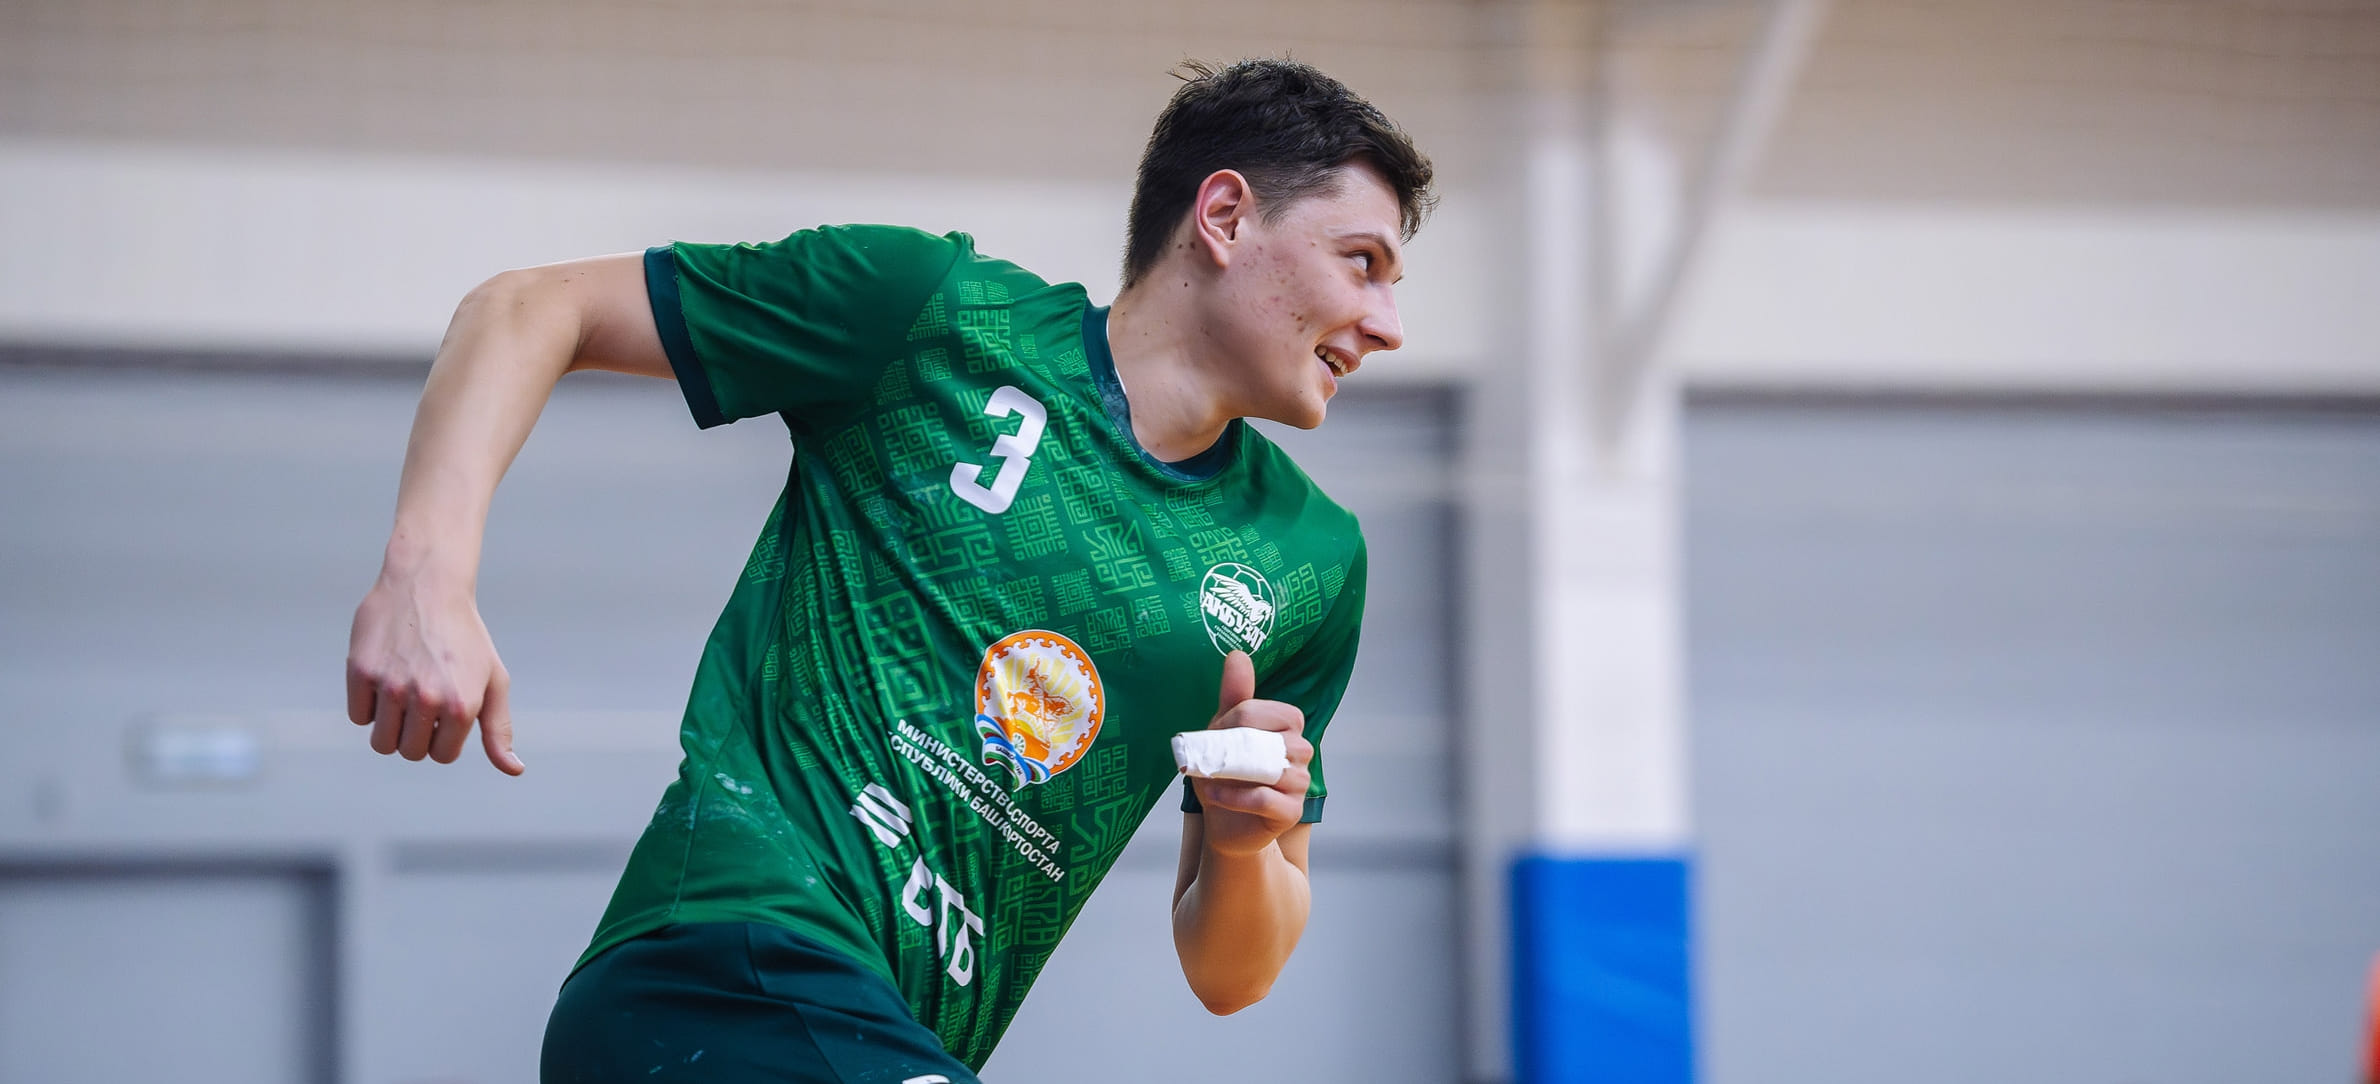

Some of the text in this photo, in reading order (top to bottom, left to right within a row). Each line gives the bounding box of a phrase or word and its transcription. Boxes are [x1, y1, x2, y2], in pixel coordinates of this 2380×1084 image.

[950, 385, 1047, 514] 3
[1200, 591, 1267, 651] АКБУЗАТ
[888, 731, 971, 802] СПУБЛИКИ
[1010, 808, 1060, 855] СПОРТА
